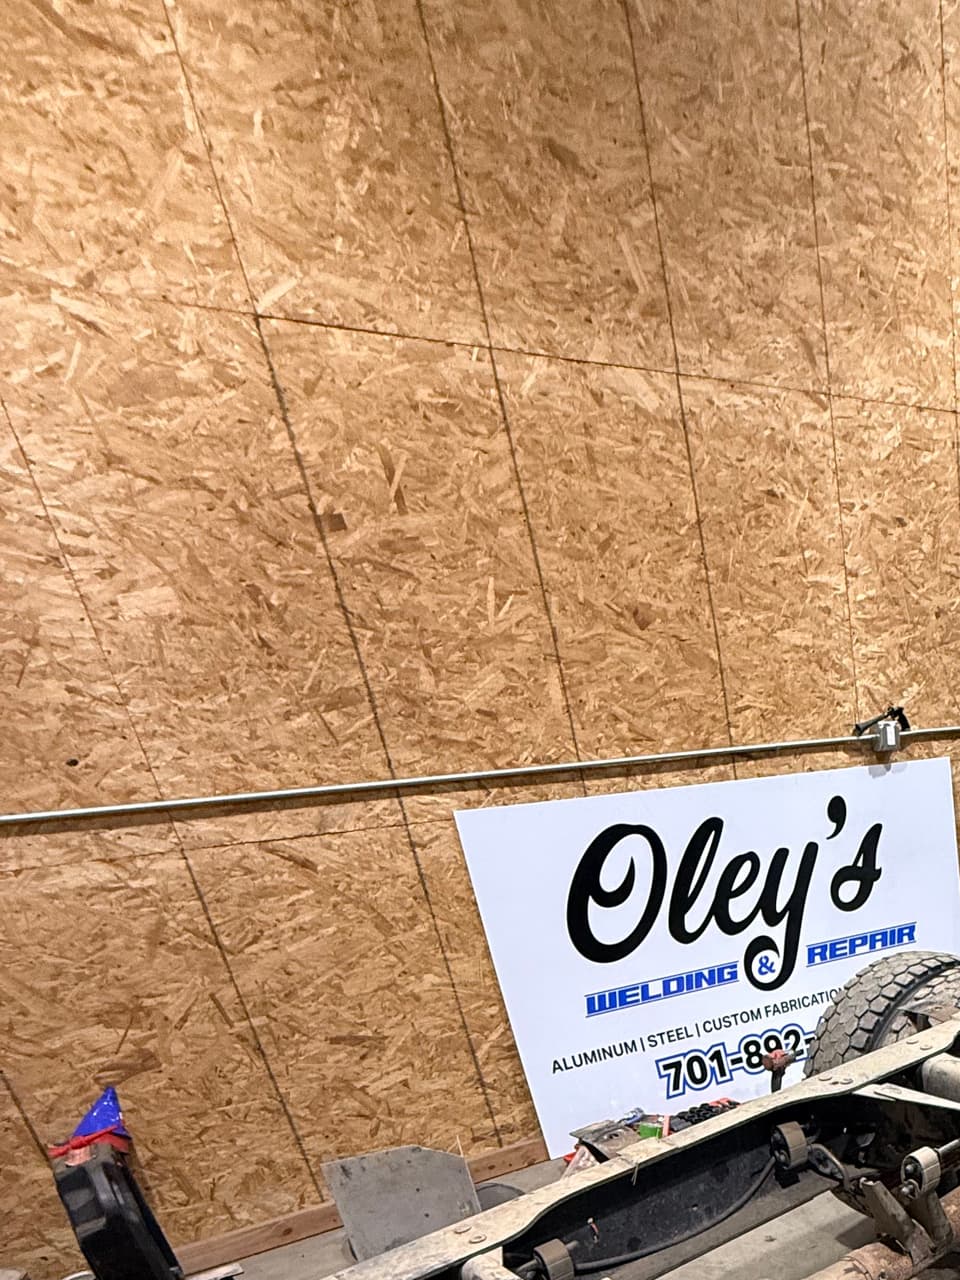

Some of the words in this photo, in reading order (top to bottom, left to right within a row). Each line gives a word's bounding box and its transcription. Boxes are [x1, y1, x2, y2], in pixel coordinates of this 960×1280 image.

[567, 796, 882, 991] Oley's
[585, 963, 738, 1015] WELDING
[757, 955, 775, 976] &
[807, 924, 916, 963] REPAIR
[552, 1039, 638, 1074] ALUMINUM
[647, 1026, 694, 1048] STEEL
[702, 1008, 763, 1031] CUSTOM
[764, 987, 842, 1018] FABRICATIO
